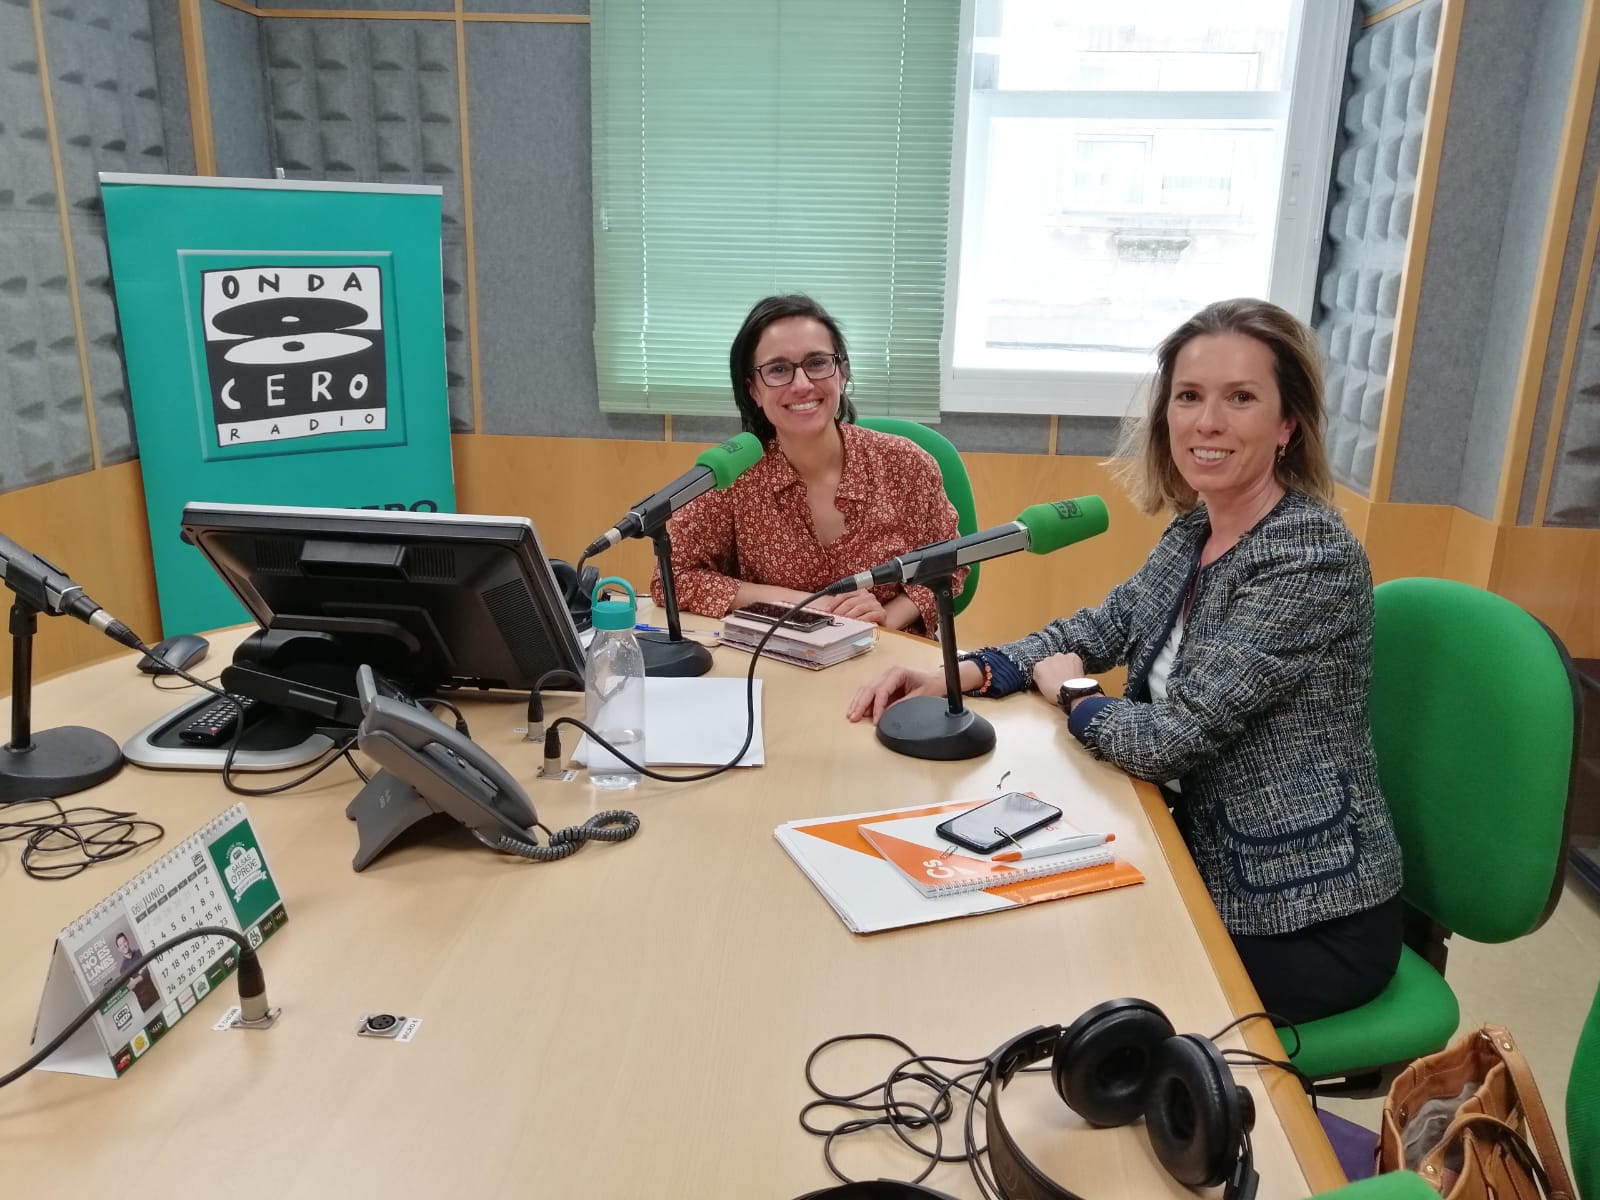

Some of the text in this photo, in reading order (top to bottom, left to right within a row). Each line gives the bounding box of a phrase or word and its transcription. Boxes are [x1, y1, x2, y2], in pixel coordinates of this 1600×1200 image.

[221, 272, 363, 299] ONDA
[220, 371, 369, 410] CERO
[230, 414, 375, 441] RADIO
[142, 884, 165, 908] JUNIO
[195, 883, 200, 891] 1
[204, 876, 209, 884] 2
[170, 922, 177, 931] 5
[181, 914, 187, 922] 6
[190, 906, 195, 914] 7
[200, 898, 206, 906] 8
[209, 890, 215, 898] 9
[205, 910, 213, 921] 15
[214, 904, 223, 913] 16
[81, 955, 98, 973] NO
[96, 945, 111, 960] ES
[86, 954, 115, 981] LUNES
[161, 967, 169, 978] 17
[171, 958, 181, 970] 18
[181, 950, 190, 961] 19
[190, 941, 200, 953] 20
[166, 983, 176, 995] 24
[177, 973, 186, 985] 25
[187, 964, 197, 977] 26
[197, 955, 205, 967] 27
[206, 946, 216, 959] 28
[215, 938, 225, 950] 29
